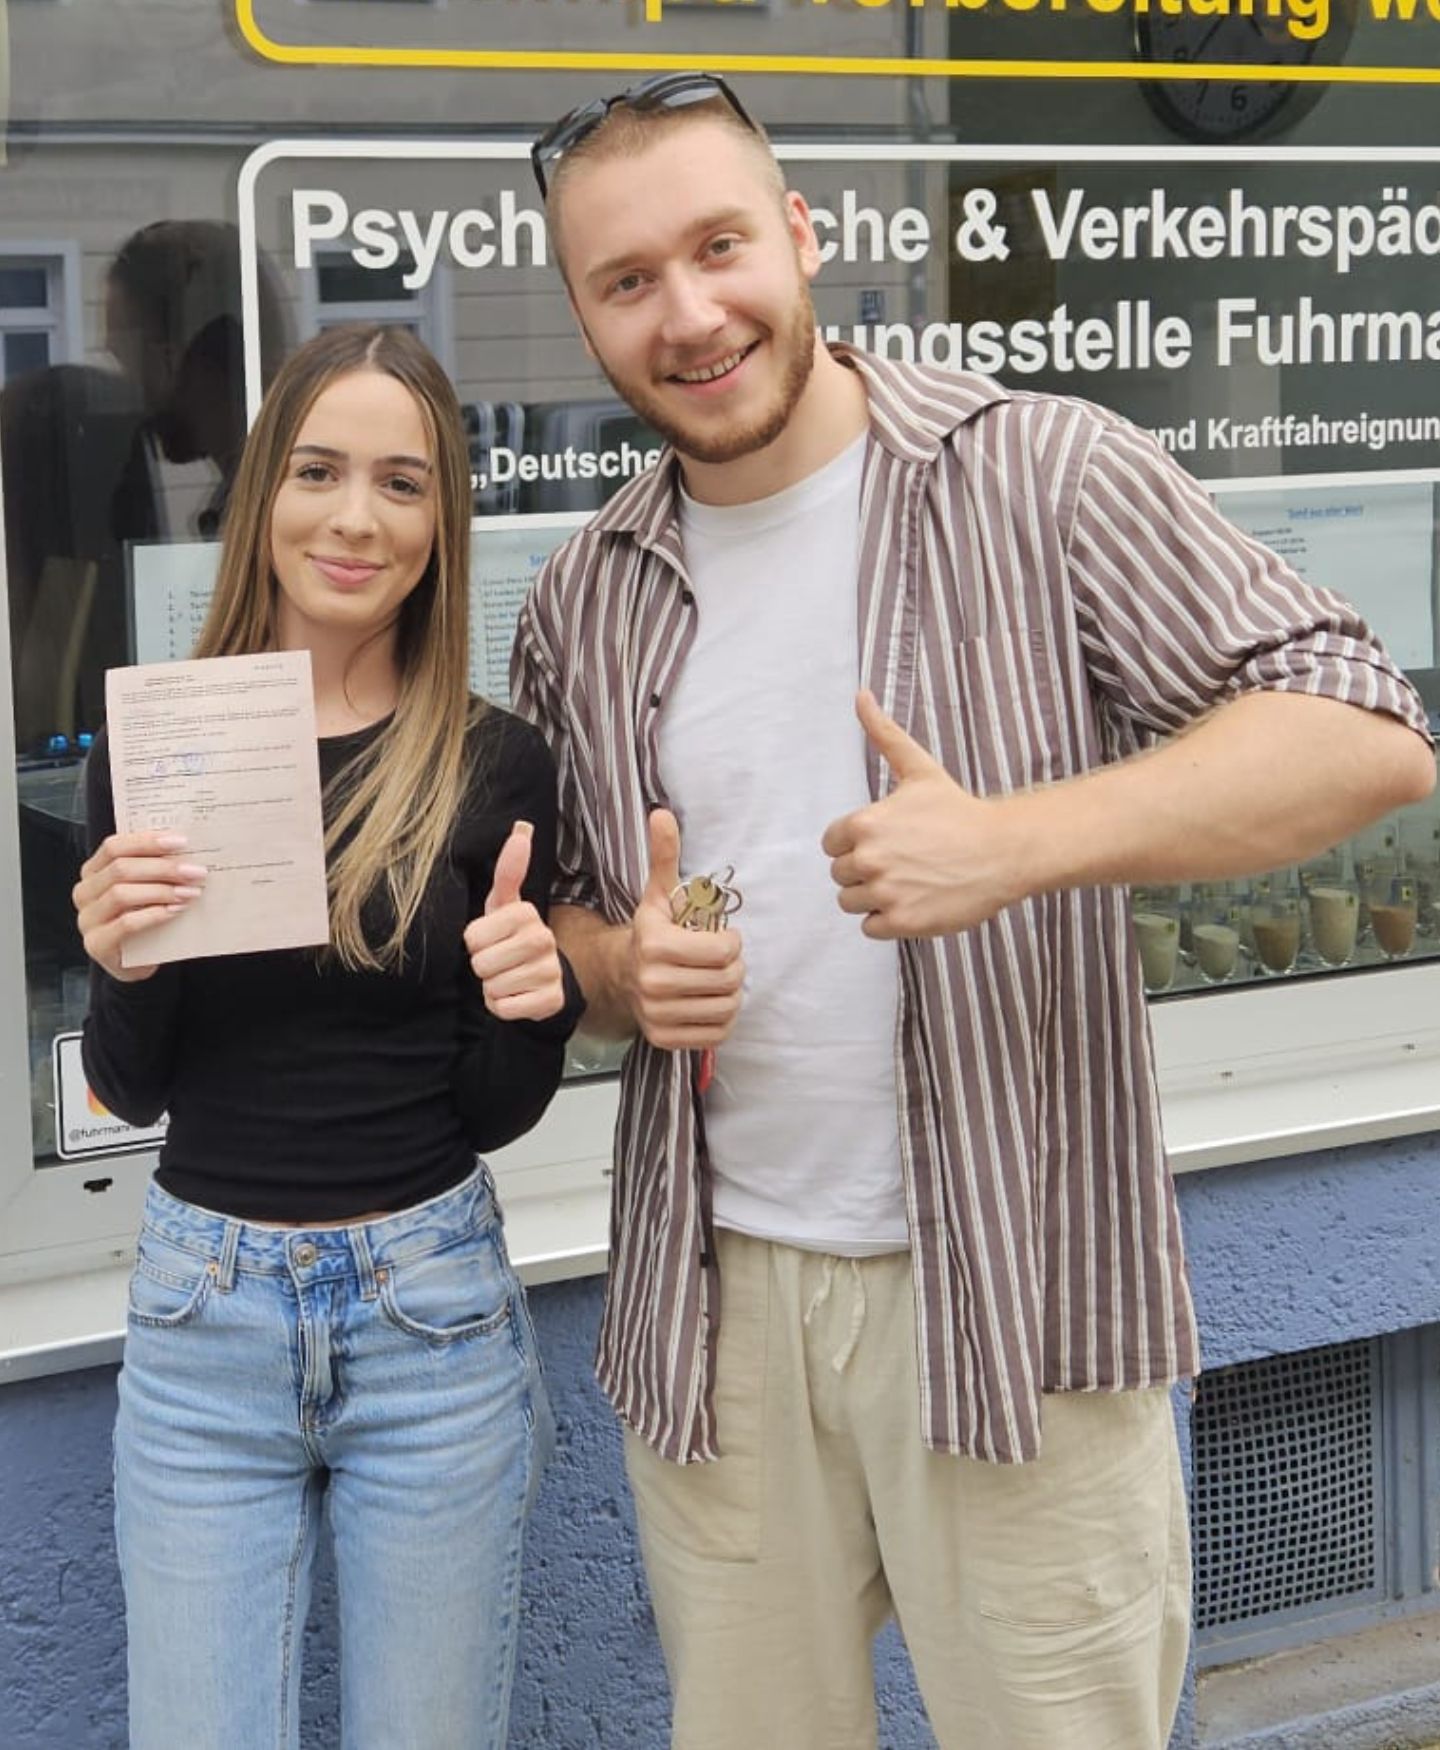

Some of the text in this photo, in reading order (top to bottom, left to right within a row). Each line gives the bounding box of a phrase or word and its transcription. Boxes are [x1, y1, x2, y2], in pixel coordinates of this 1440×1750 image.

[1231, 85, 1248, 112] 6
[291, 190, 930, 289] Psychche
[956, 189, 1010, 262] &
[815, 298, 1192, 374] ngsstelle
[1149, 419, 1196, 451] nd
[1207, 412, 1440, 450] Kraftfahreignun
